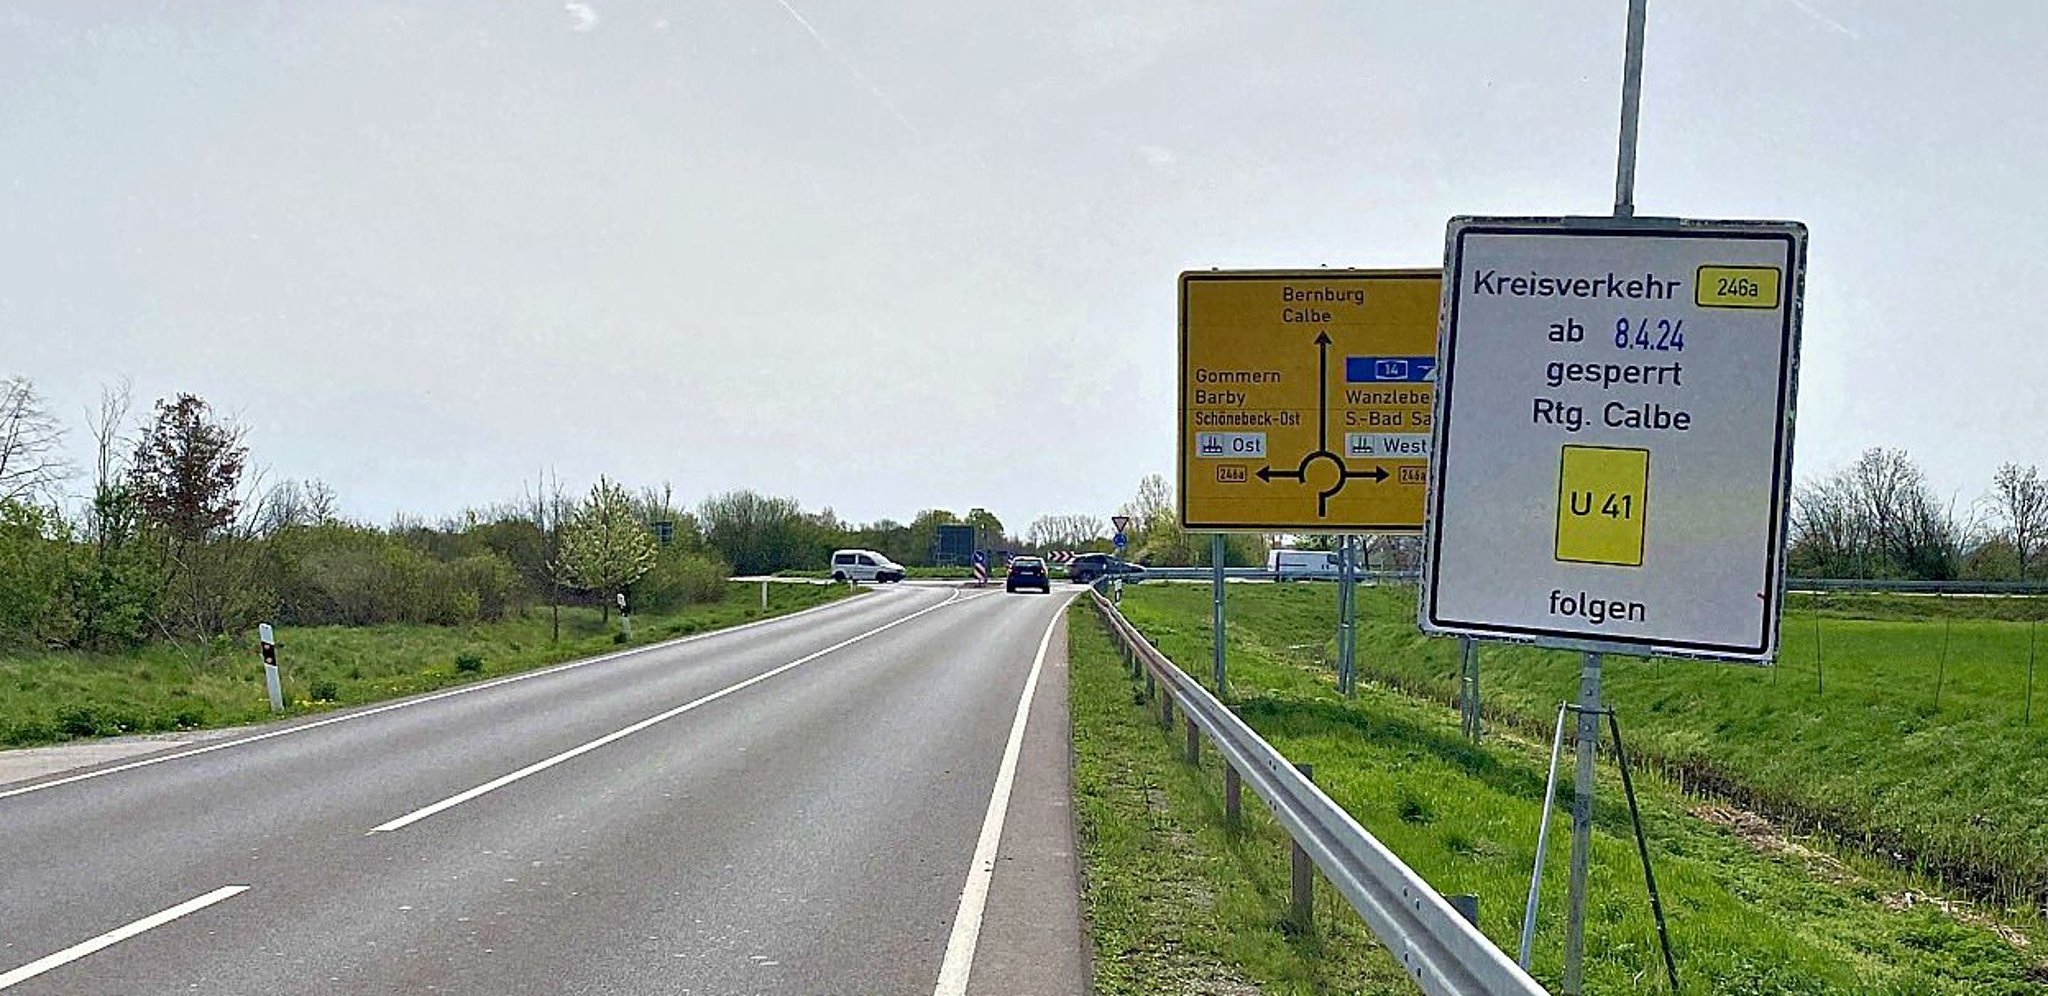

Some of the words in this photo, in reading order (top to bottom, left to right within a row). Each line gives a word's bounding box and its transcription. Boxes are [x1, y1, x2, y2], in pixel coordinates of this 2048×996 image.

[1473, 269, 1681, 301] Kreisverkehr
[1716, 278, 1759, 298] 246a
[1282, 287, 1365, 305] Bernburg
[1282, 308, 1331, 323] Calbe
[1548, 319, 1585, 343] ab
[1614, 317, 1685, 352] 8.4.24
[1195, 368, 1281, 384] Gommern
[1384, 363, 1399, 376] 14
[1546, 361, 1682, 390] gesperrt
[1195, 390, 1246, 407] Barby
[1346, 389, 1430, 405] Wanzlebe
[1195, 411, 1301, 426] Schönebeck-Ost
[1346, 411, 1402, 426] S.-Bad
[1412, 411, 1431, 427] Sa
[1533, 399, 1591, 431] Rtg.
[1603, 401, 1691, 431] Calbe
[1232, 437, 1261, 453] Ost
[1383, 437, 1427, 454] West
[1570, 493, 1592, 516] U
[1601, 494, 1632, 520] 41
[1548, 591, 1646, 623] folgen
